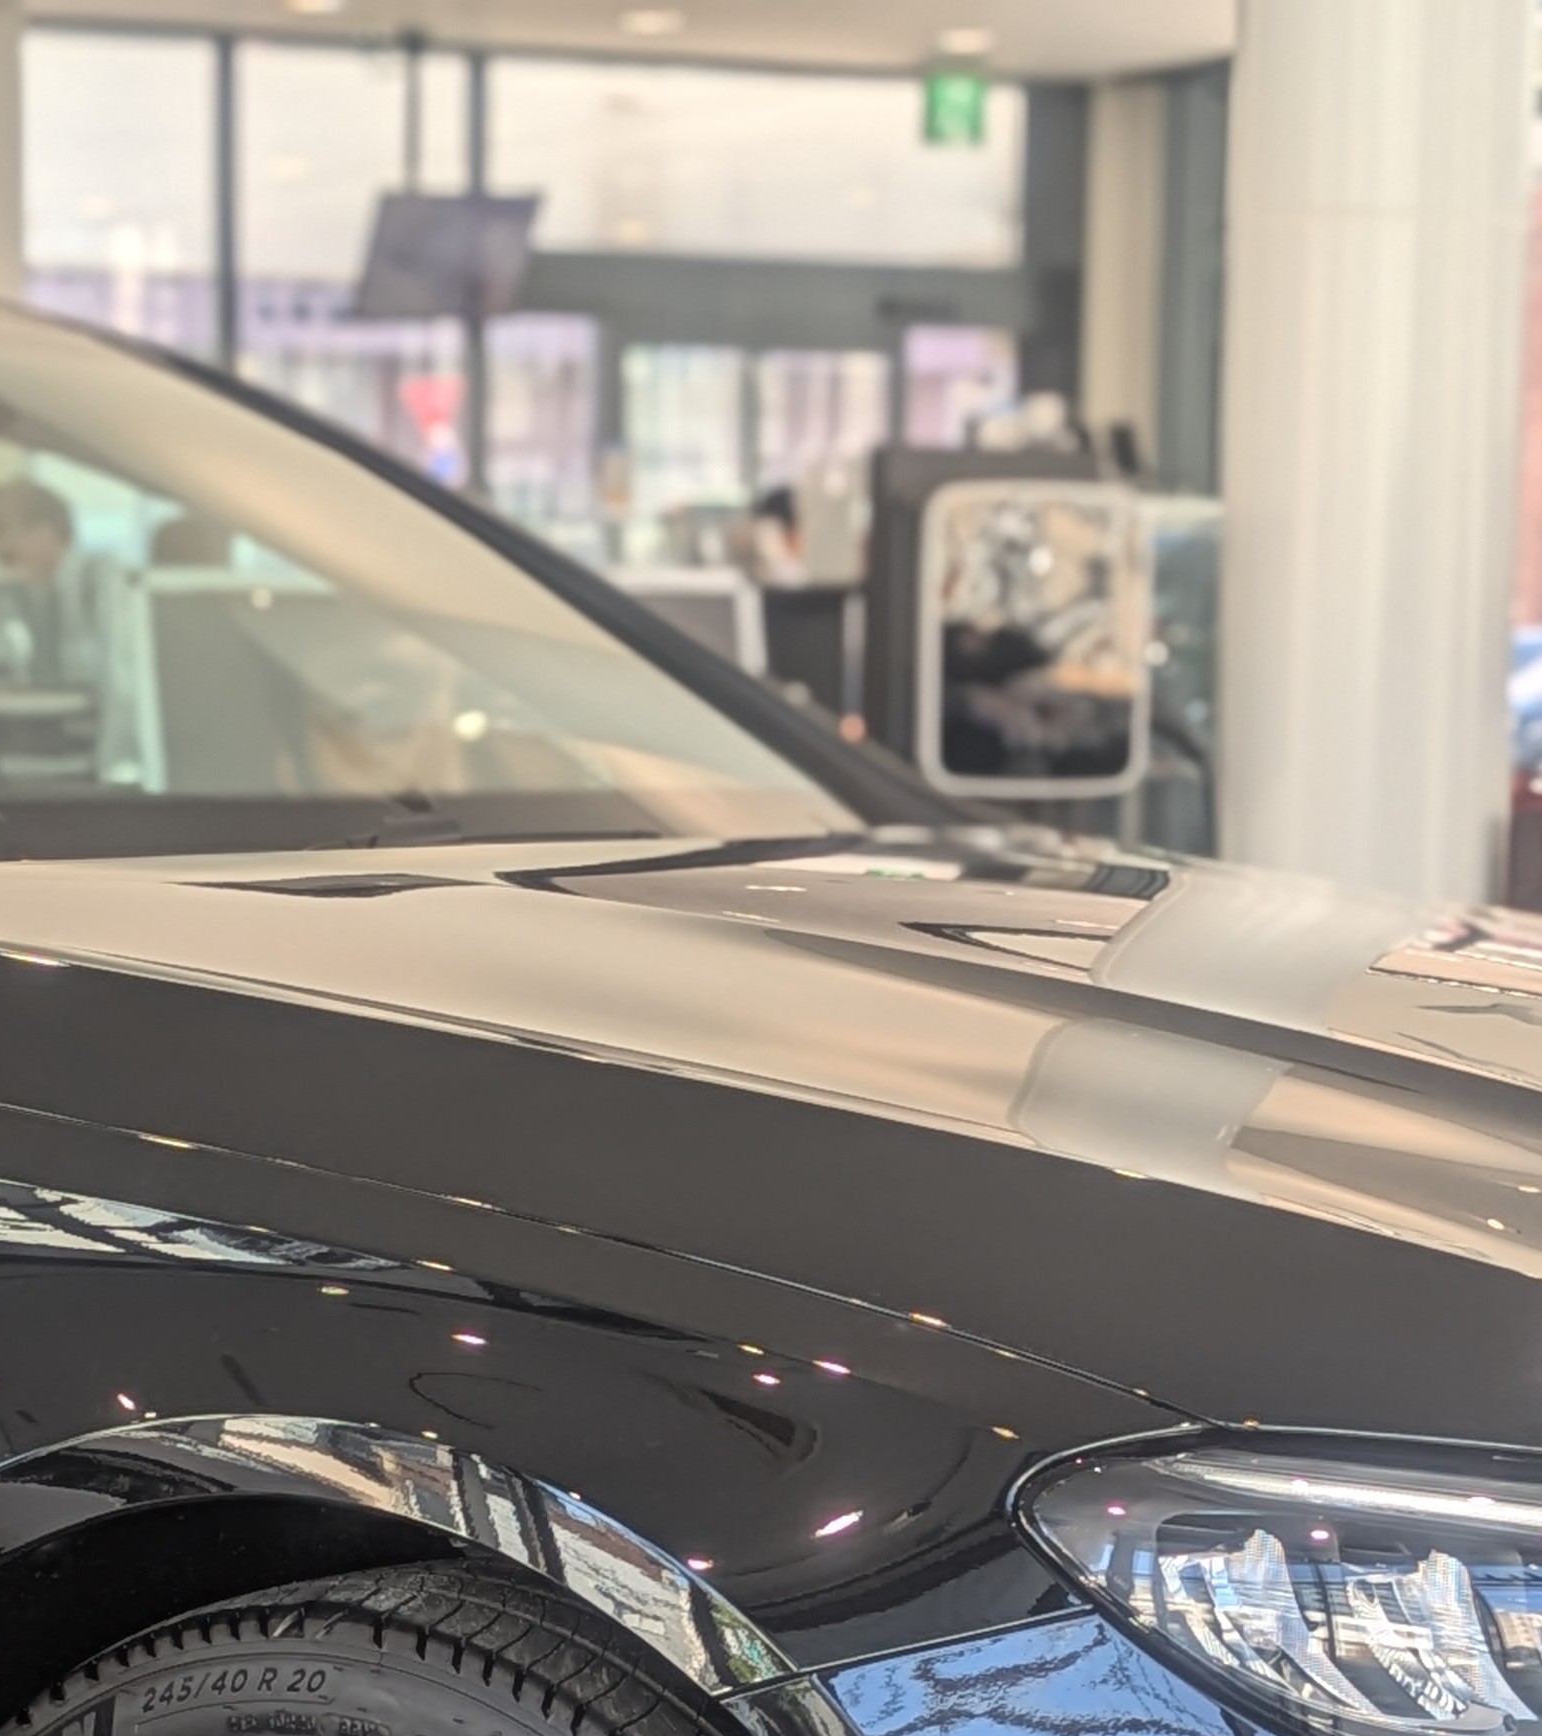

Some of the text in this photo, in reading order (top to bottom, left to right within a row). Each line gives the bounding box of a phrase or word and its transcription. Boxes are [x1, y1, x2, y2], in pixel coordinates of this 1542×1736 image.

[141, 1667, 327, 1713] 245/40 R 20
